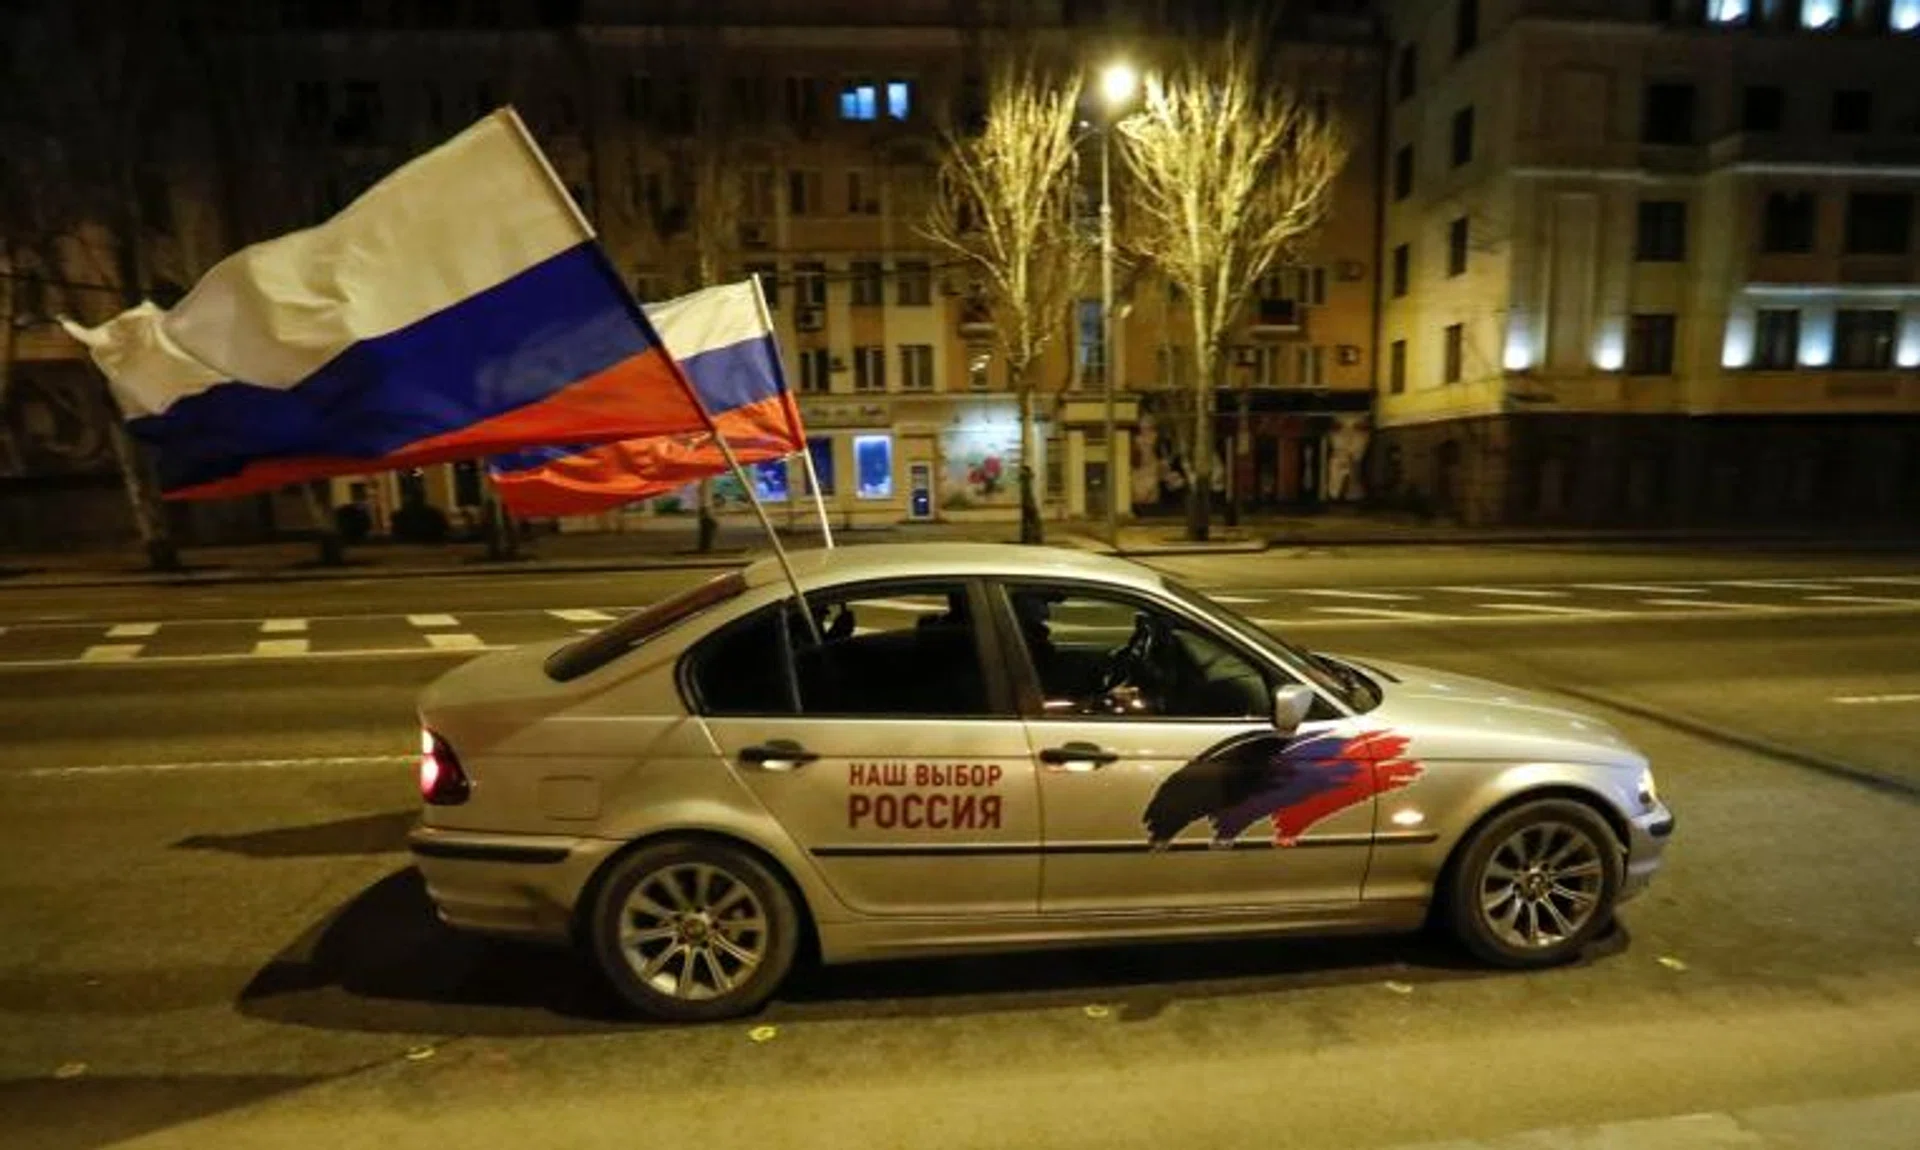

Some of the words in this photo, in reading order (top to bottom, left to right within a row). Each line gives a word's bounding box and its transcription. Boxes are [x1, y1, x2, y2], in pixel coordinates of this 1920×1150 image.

[849, 764, 907, 786] НАШ
[915, 764, 1002, 786] ВЫБОР
[848, 794, 1002, 829] РОССИЯ
